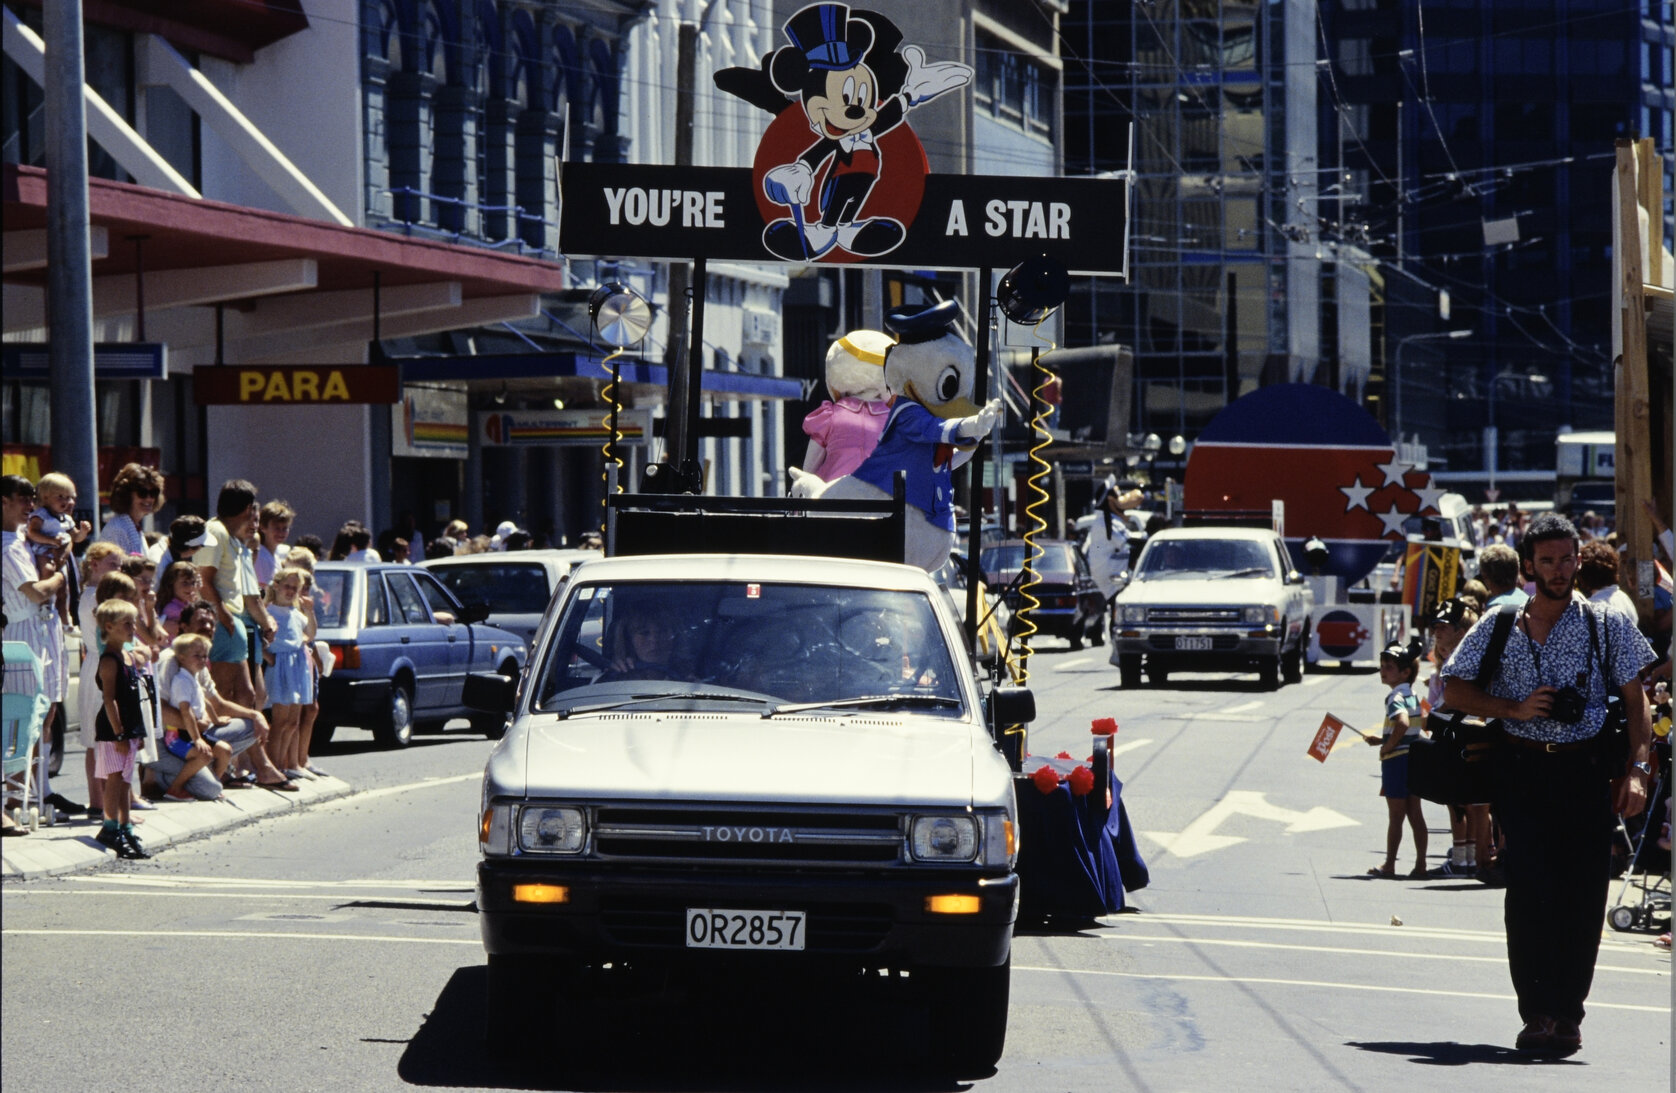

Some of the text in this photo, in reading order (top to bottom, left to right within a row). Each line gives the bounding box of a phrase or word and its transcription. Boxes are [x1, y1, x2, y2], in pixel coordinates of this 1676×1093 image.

[603, 187, 1071, 239] YOU'RE A STAR
[240, 371, 350, 400] PARA
[702, 826, 794, 843] TOYOTA
[690, 913, 802, 946] OR2857
